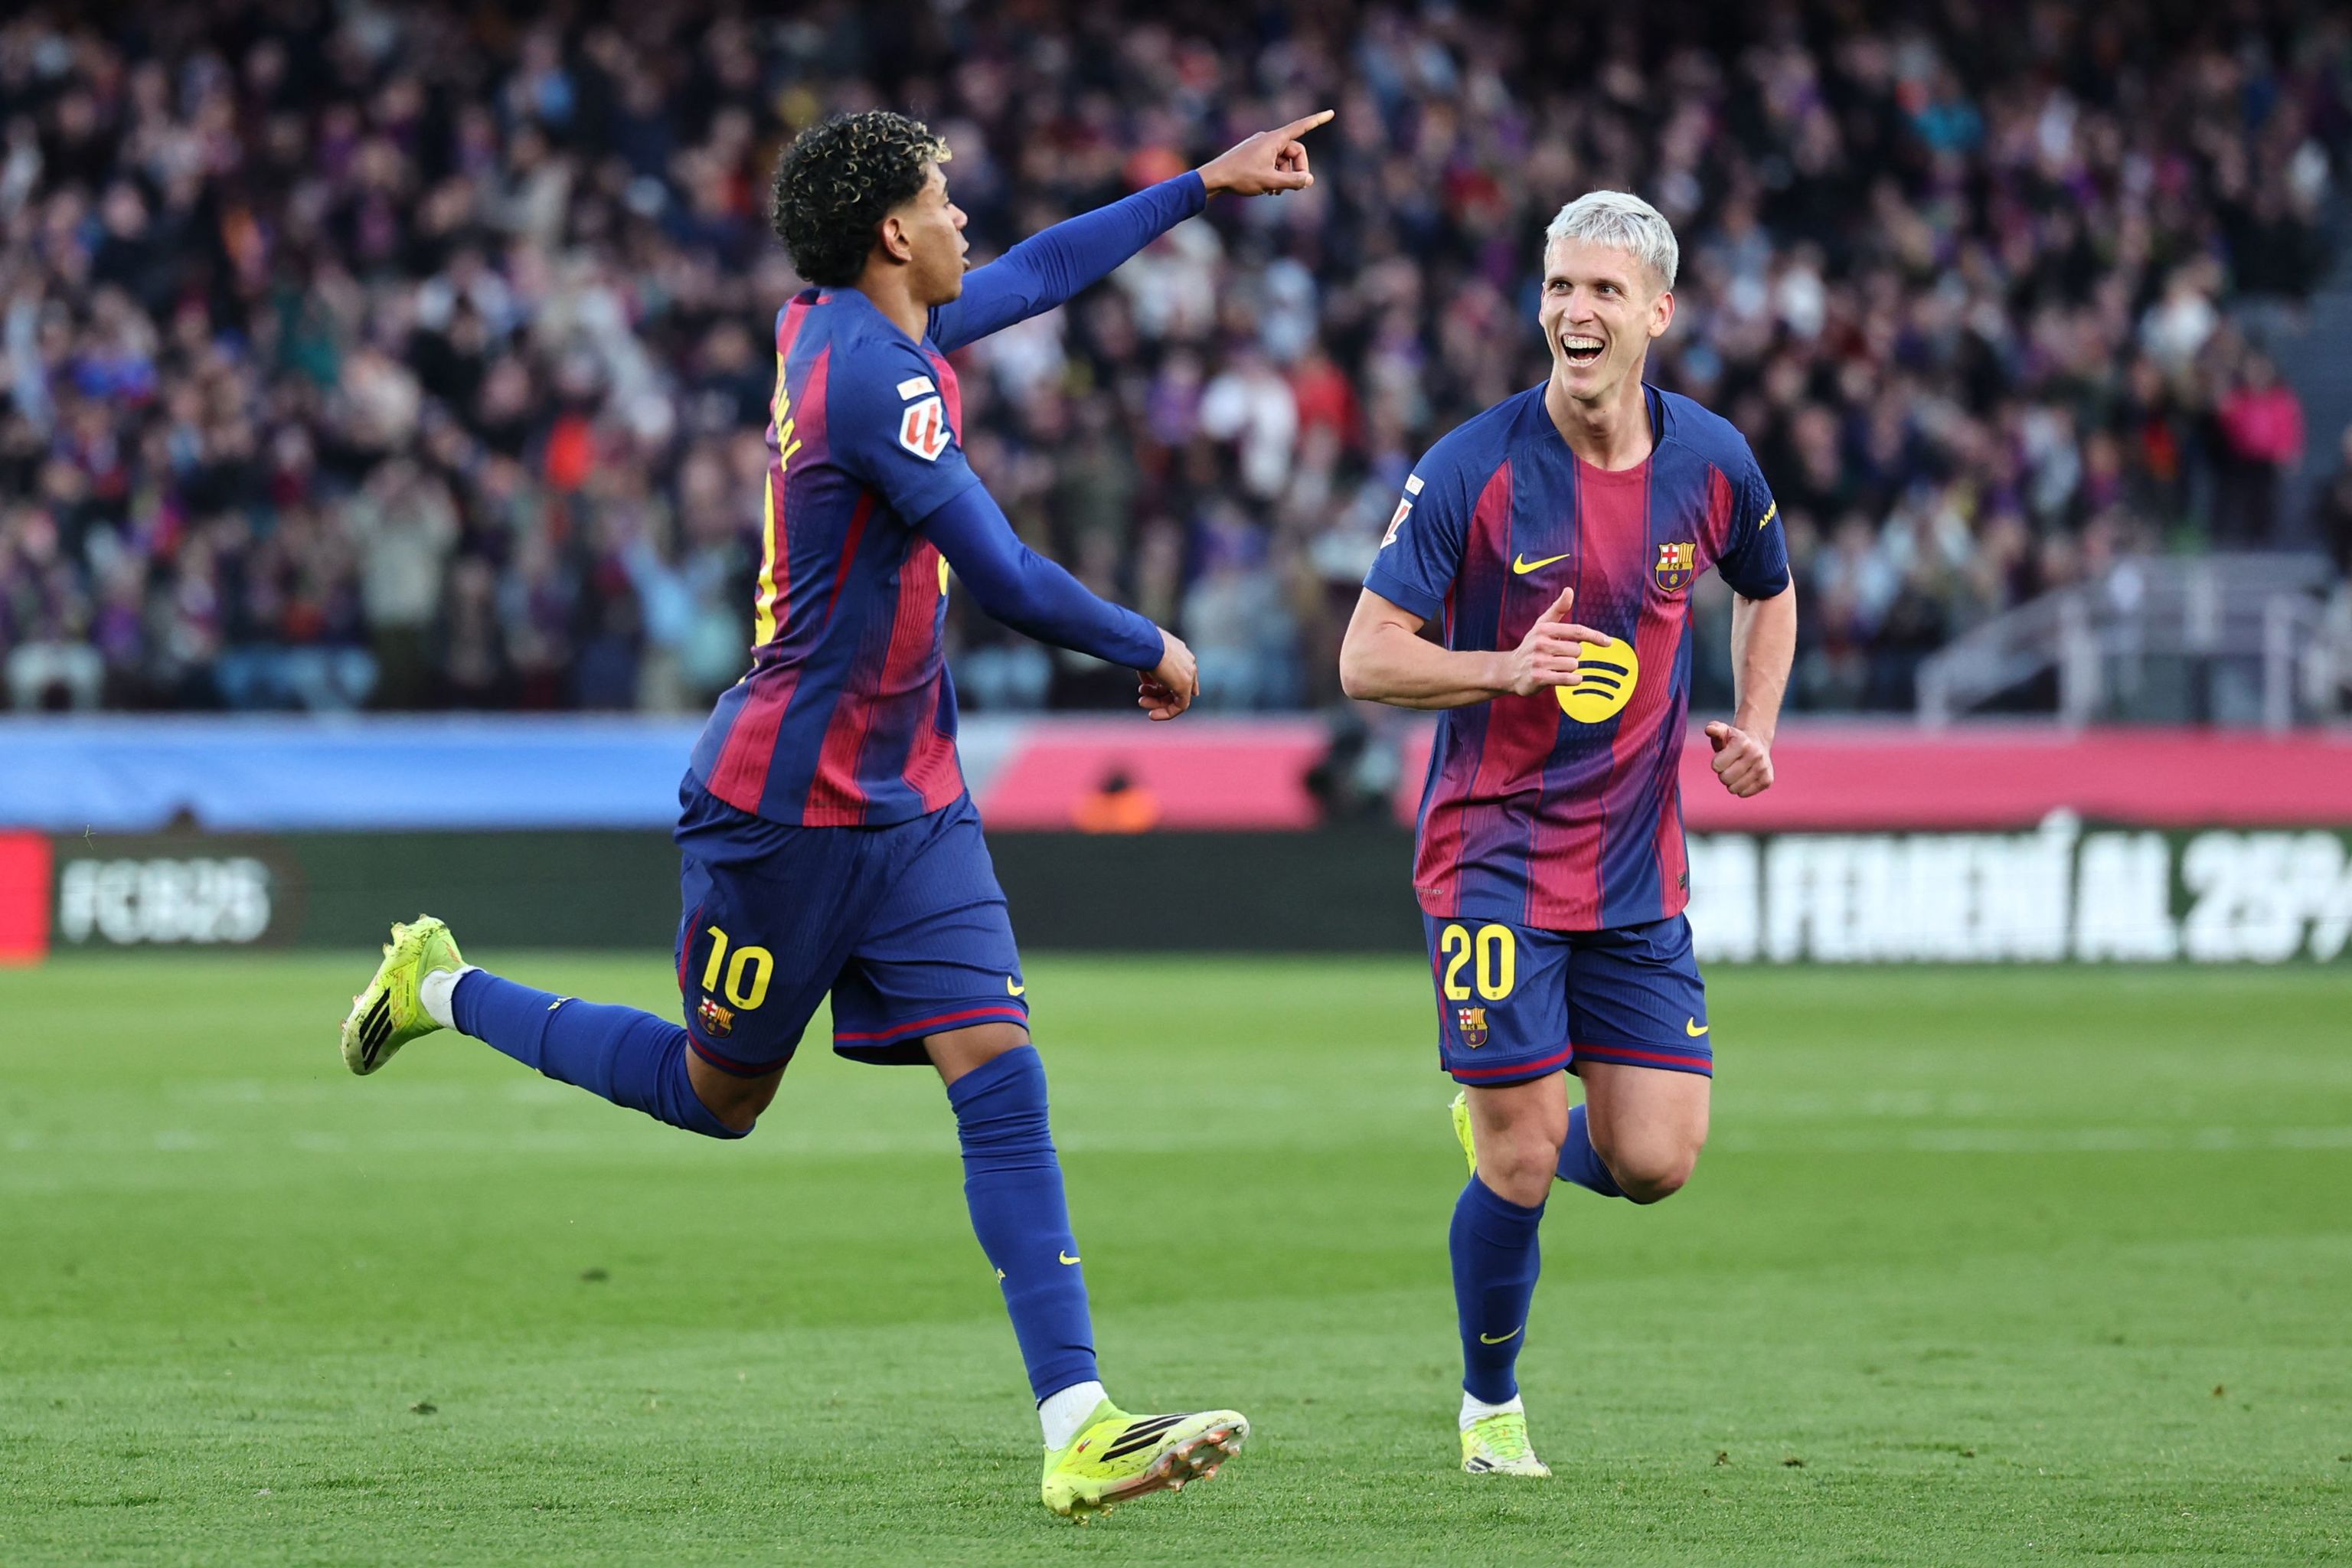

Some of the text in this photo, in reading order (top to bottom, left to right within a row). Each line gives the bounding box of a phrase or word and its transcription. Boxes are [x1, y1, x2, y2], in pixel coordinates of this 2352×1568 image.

[61, 857, 272, 945] FCB25
[2076, 831, 2179, 962] AL
[701, 926, 774, 1010] 10
[1442, 924, 1514, 1001] 20
